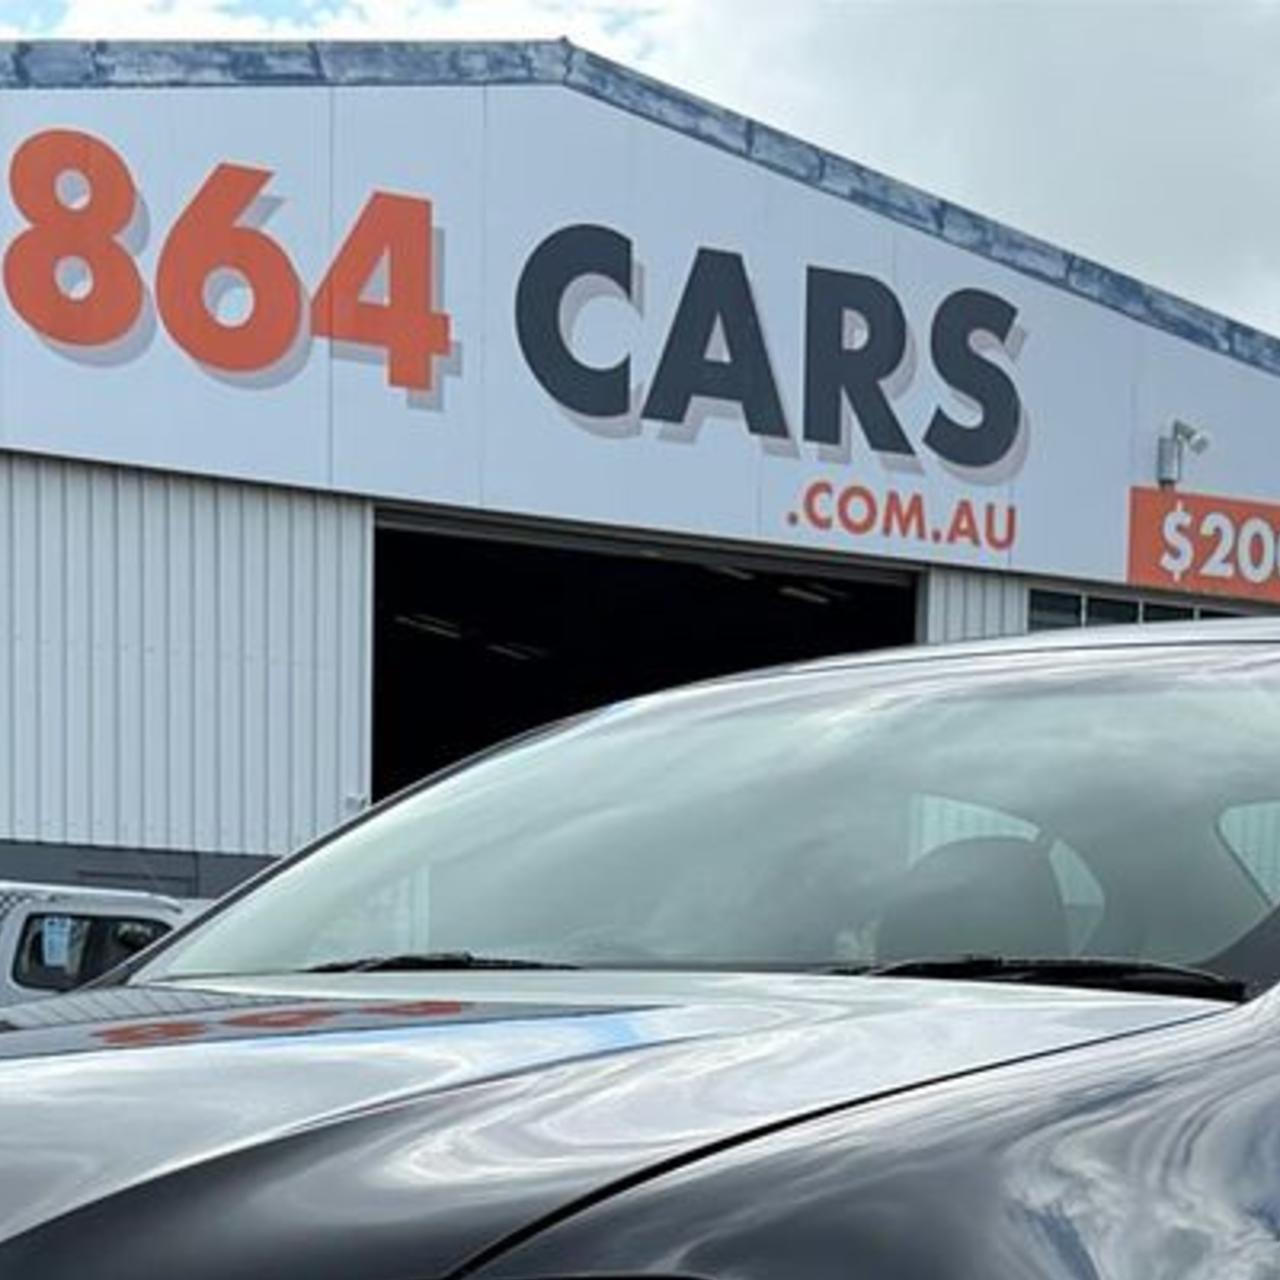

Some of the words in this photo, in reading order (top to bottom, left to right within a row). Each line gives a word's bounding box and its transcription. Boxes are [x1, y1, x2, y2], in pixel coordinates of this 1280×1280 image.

[2, 128, 451, 393] 864
[514, 223, 1022, 468] CARS
[785, 480, 1017, 551] .COM.AU
